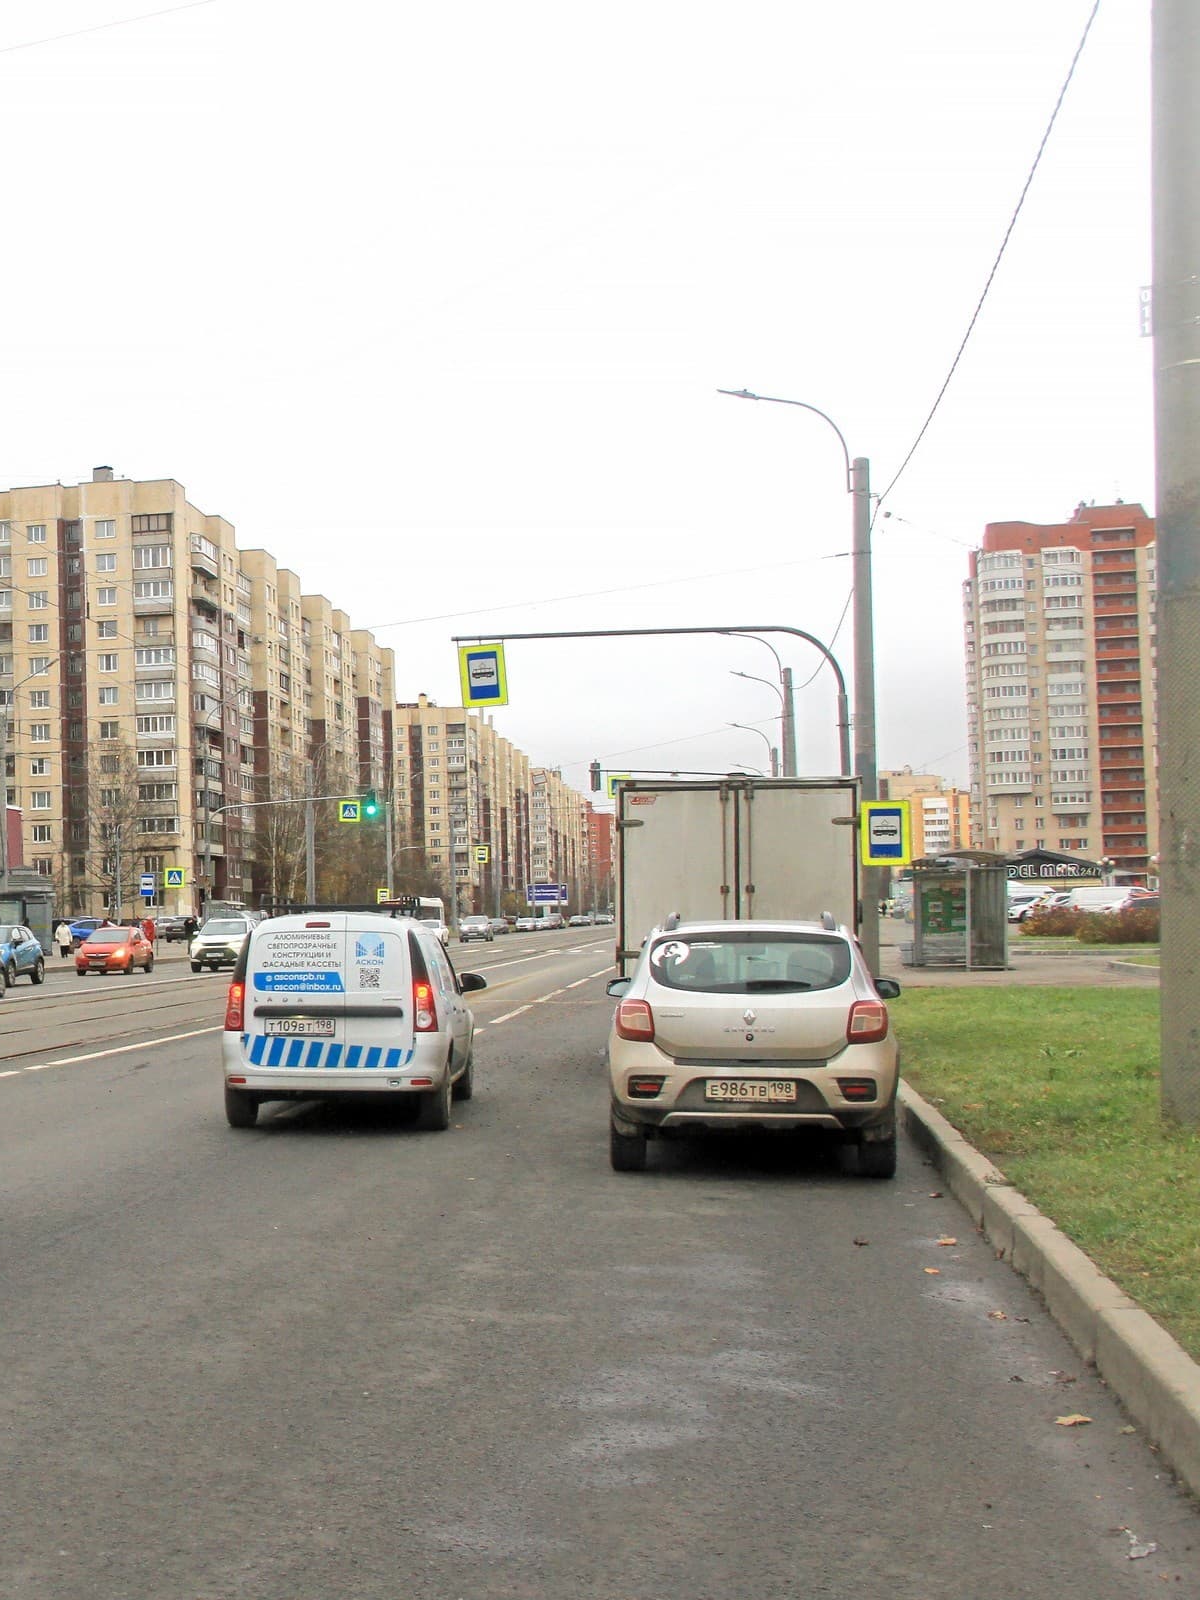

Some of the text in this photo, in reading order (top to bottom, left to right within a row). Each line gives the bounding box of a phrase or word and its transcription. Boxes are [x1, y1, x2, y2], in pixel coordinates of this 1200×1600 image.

[1006, 864, 1037, 878] DEL
[1039, 863, 1080, 878] MAR
[267, 942, 337, 950] СВЕТОПРОЗРАЧНЫЕ
[274, 972, 325, 982] asconspb.ru
[274, 983, 341, 991] ascon@inbox.ru
[315, 1020, 332, 1029] 198
[770, 1082, 792, 1094] 198
